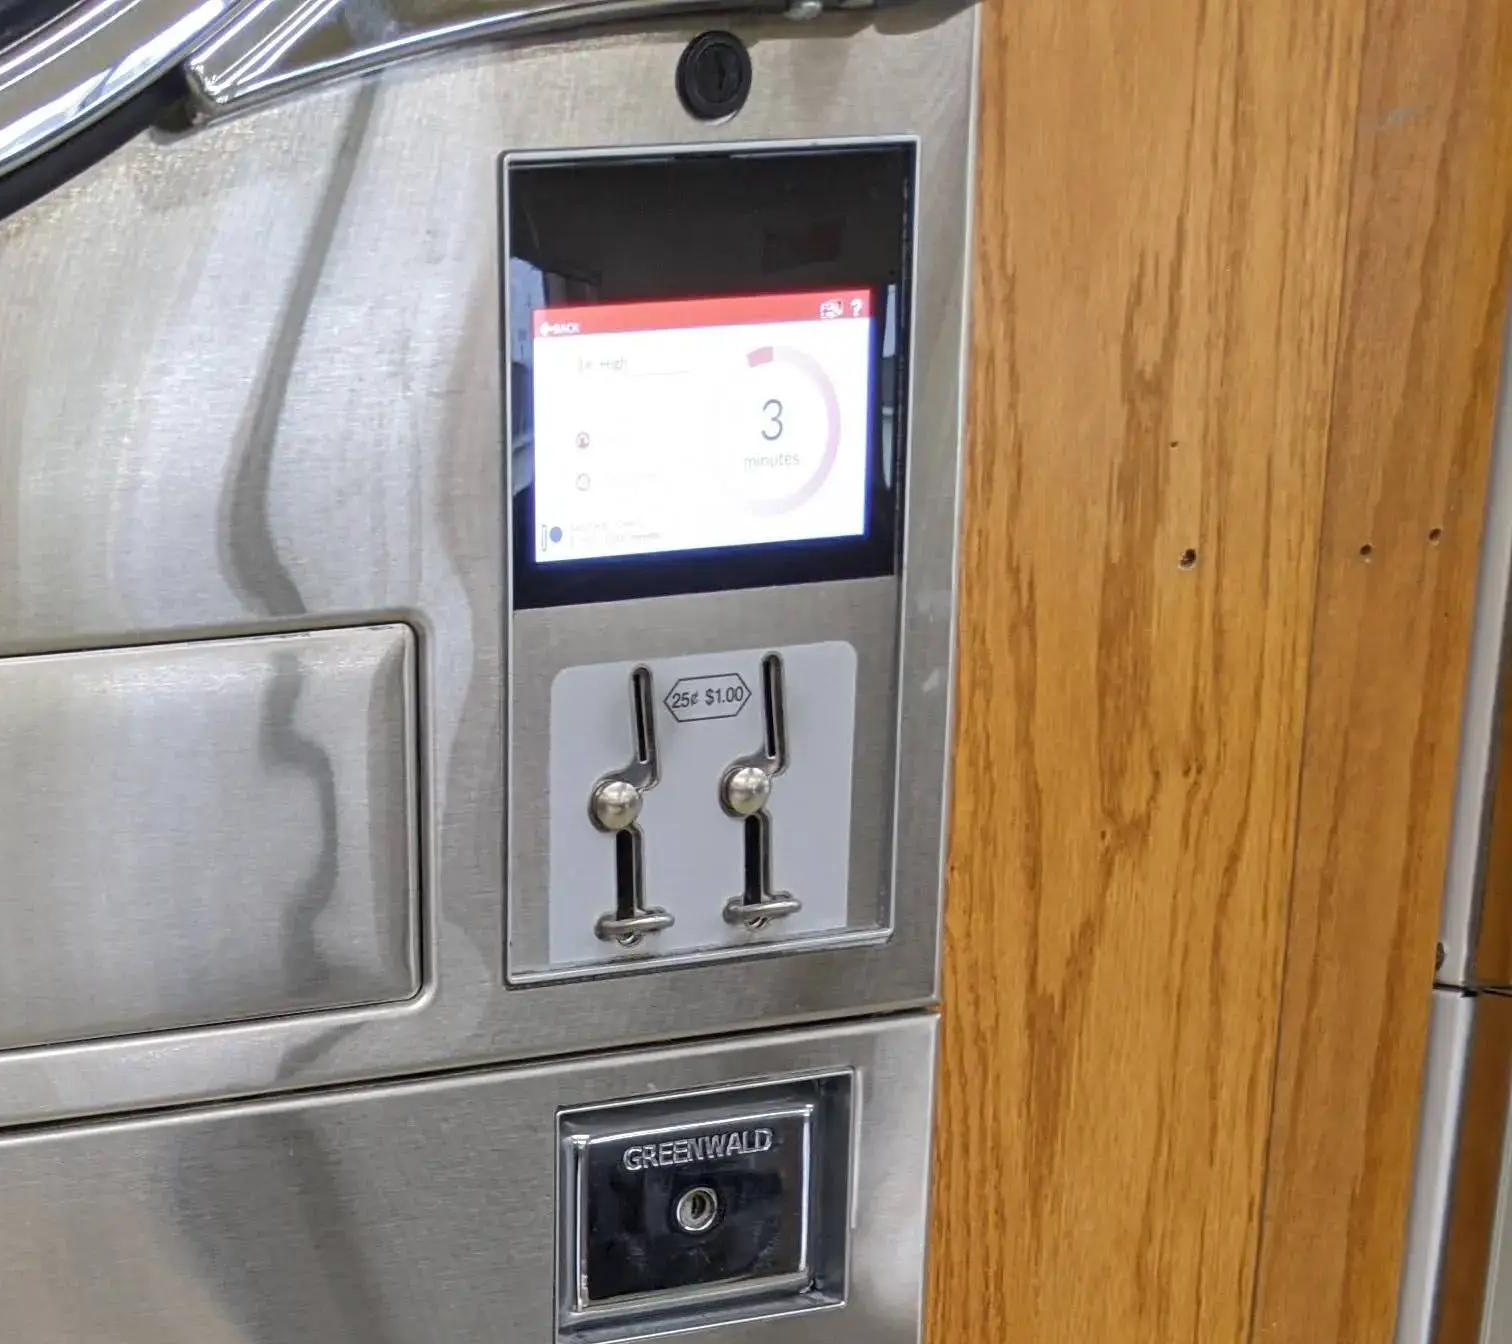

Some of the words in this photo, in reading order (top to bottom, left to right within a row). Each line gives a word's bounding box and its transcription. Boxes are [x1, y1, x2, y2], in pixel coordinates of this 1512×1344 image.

[761, 398, 783, 441] 3
[744, 453, 800, 470] minutes
[671, 690, 699, 709] 25¢
[705, 686, 744, 706] $1.00
[623, 1128, 773, 1171] GREENWALD
